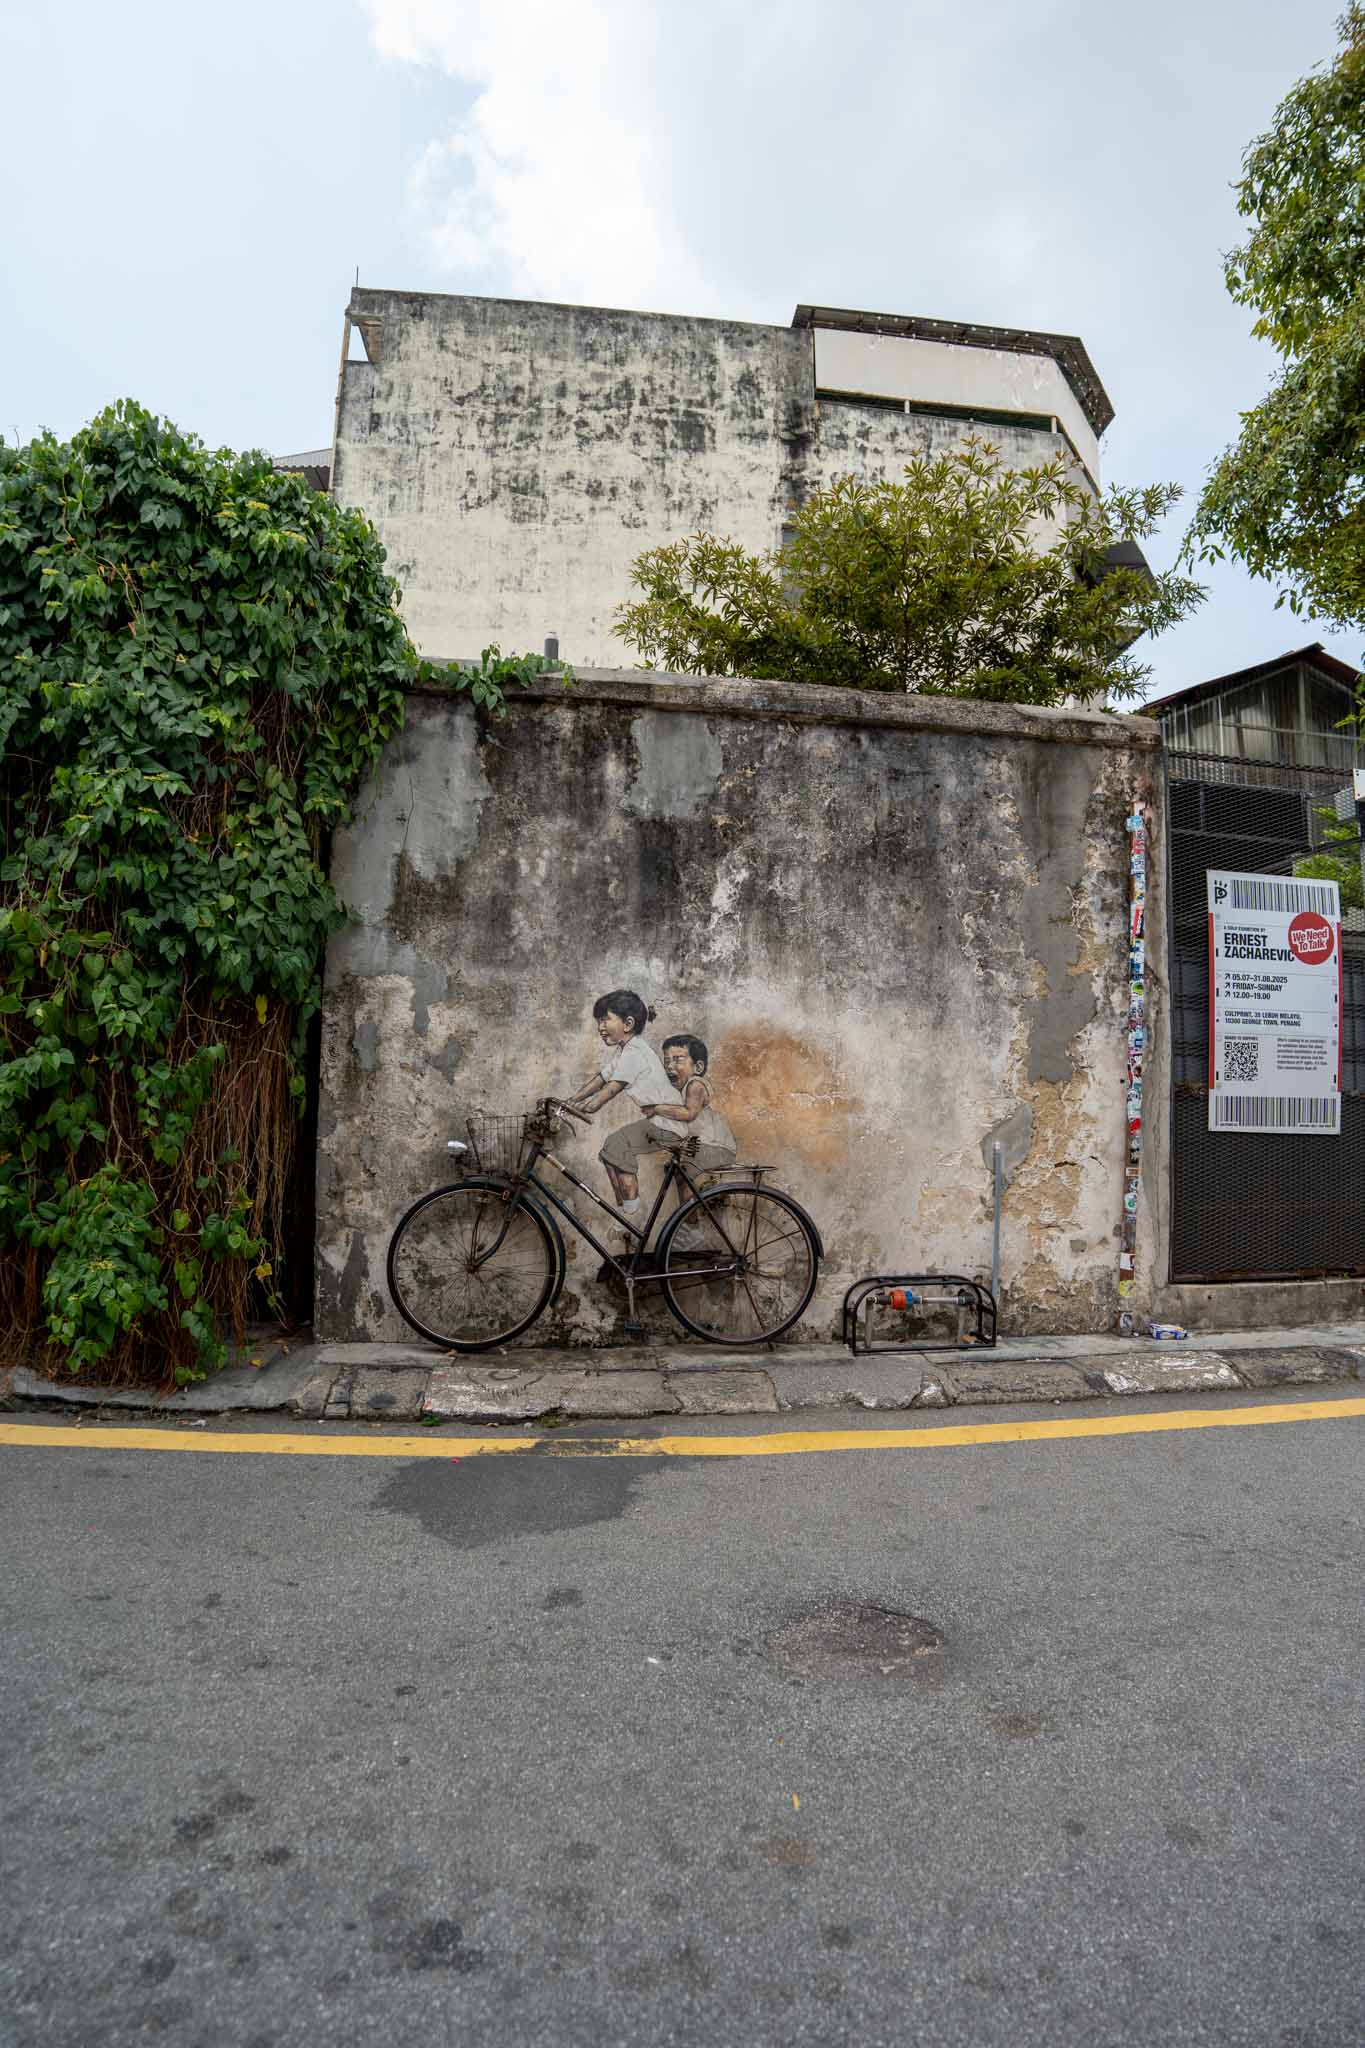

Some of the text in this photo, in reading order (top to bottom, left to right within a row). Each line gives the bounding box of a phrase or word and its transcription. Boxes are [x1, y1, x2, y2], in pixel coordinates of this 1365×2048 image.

[1224, 933, 1267, 947] ERNEST
[1292, 928, 1327, 943] We Need
[1299, 938, 1326, 951] To Talk
[1224, 945, 1294, 962] ZACHAREVIC
